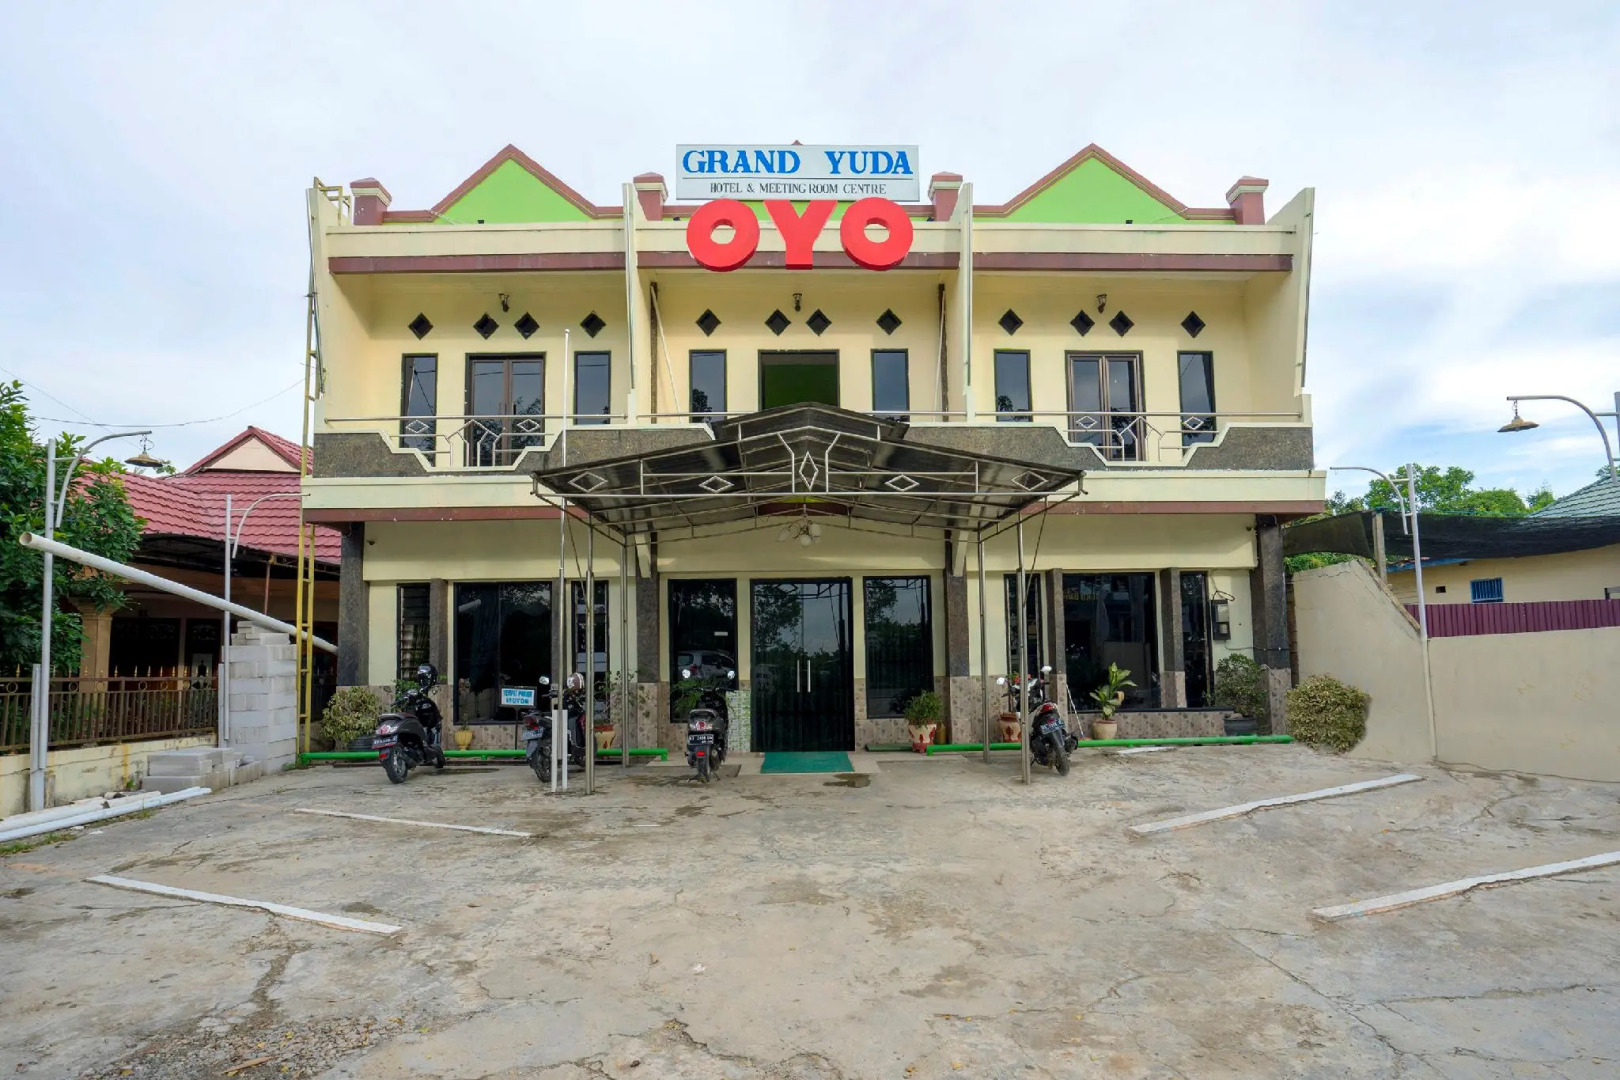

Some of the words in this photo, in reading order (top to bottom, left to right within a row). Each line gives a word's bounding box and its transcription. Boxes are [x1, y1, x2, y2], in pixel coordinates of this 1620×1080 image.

[682, 149, 800, 174] GRAND
[824, 150, 914, 175] YUDA
[710, 182, 743, 194] HOTEL
[746, 183, 755, 194] &
[759, 183, 806, 194] MEETING
[808, 183, 838, 194] ROOM
[843, 183, 887, 195] CENTRE
[686, 197, 914, 272] OYO
